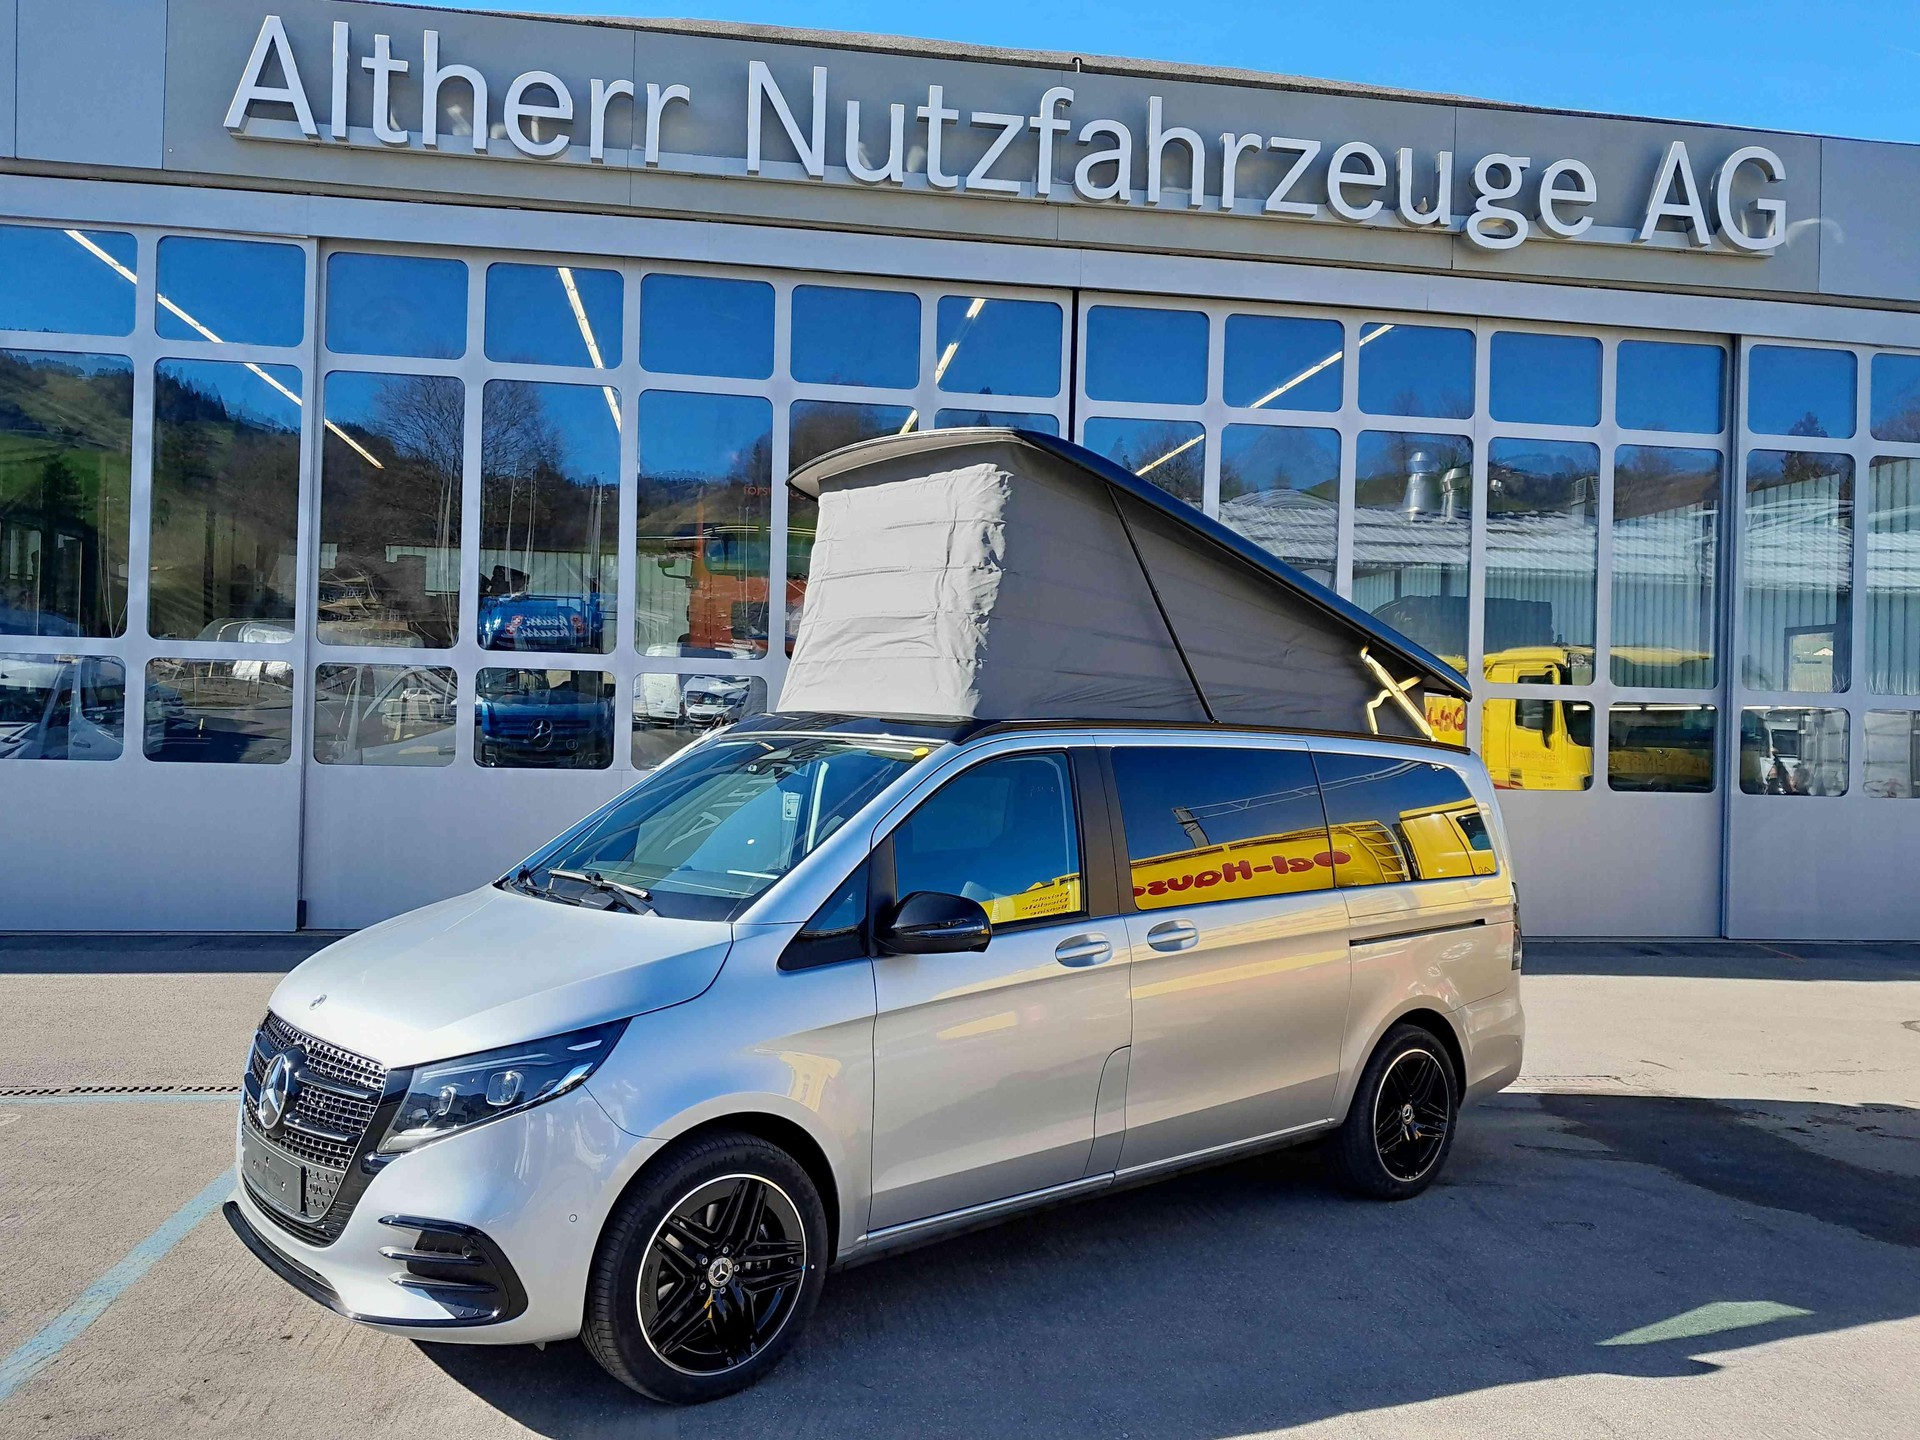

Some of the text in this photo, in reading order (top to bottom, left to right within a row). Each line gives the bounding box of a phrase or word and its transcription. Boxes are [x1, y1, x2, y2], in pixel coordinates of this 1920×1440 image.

[223, 14, 1787, 253] Altherr Nutzfahrzeuge AG
